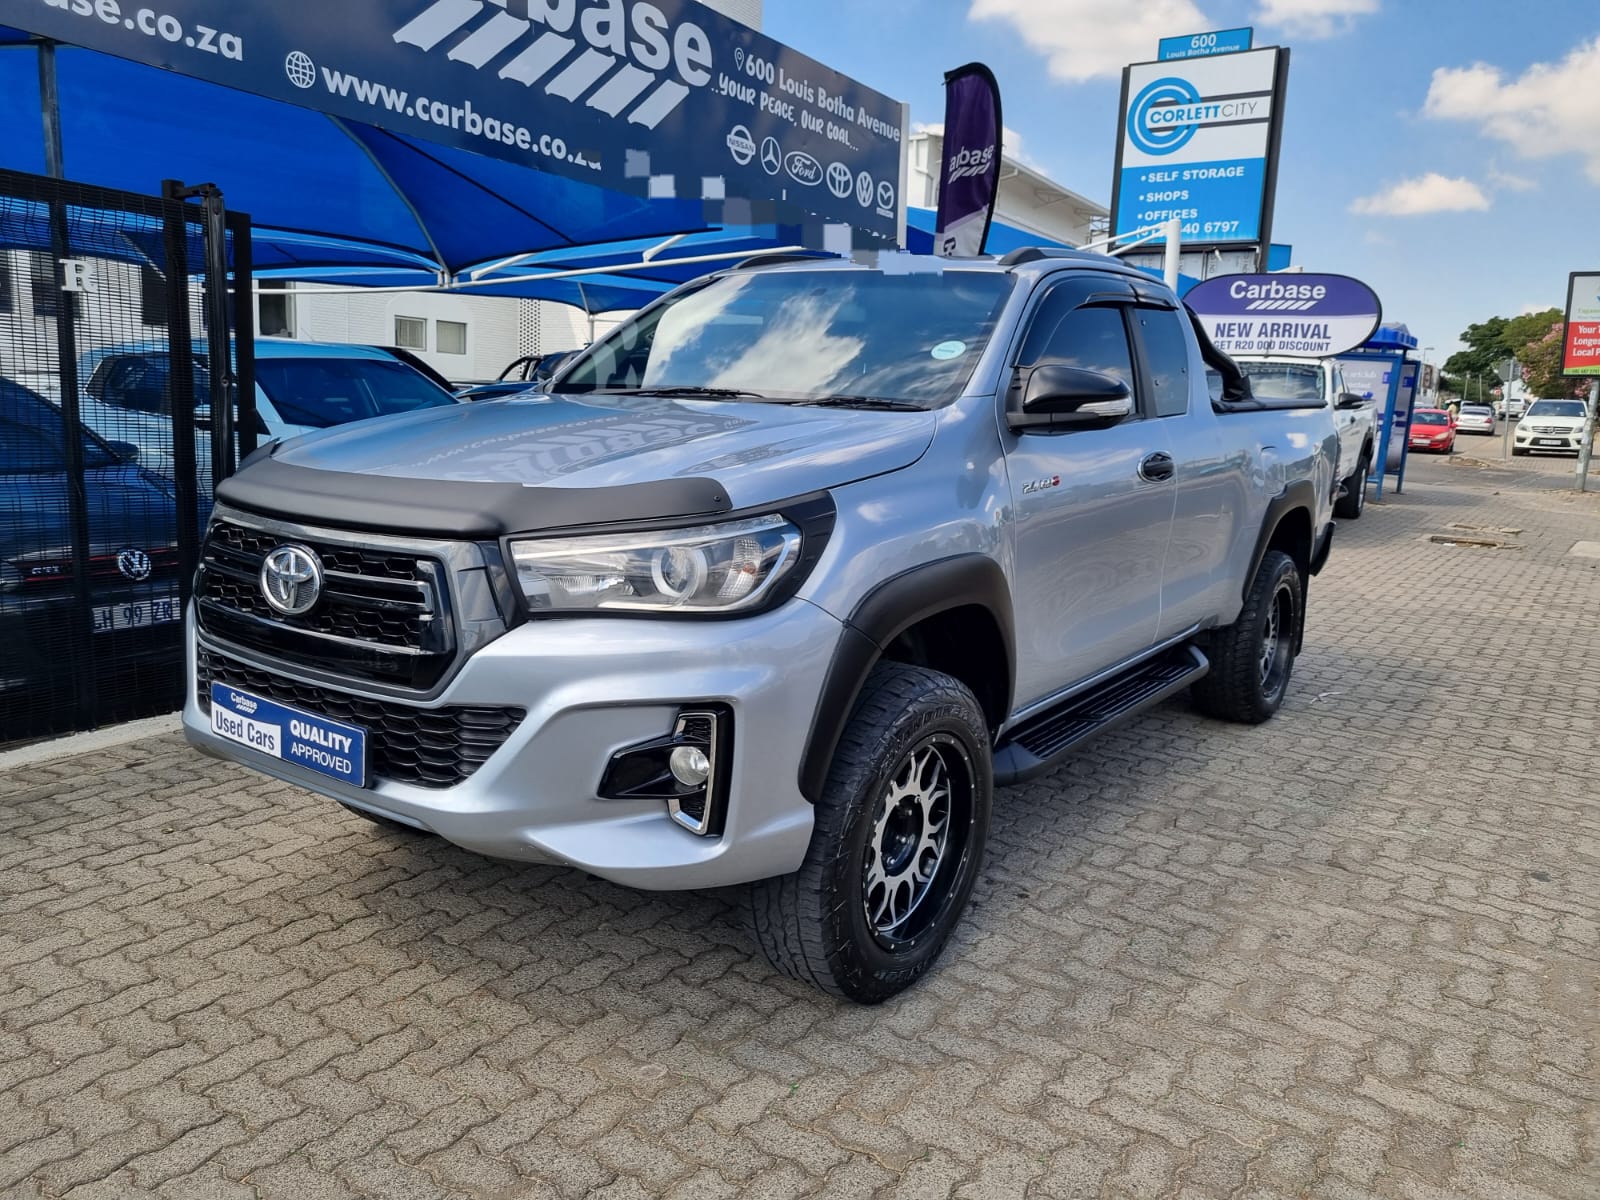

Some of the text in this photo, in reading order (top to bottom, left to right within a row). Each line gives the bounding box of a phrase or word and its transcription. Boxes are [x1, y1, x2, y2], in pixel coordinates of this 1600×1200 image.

[1191, 33, 1217, 49] 600
[1166, 45, 1240, 59] Louis Botha Avenue
[746, 54, 900, 142] 600 Louis Botha Avenue
[801, 110, 825, 136] OUR
[791, 156, 816, 180] Ford
[1148, 166, 1245, 183] SELF STORAGE
[1146, 190, 1189, 202] SHOPS
[1144, 208, 1198, 221] OFFICES
[1204, 221, 1239, 233] 6797
[1230, 280, 1326, 299] Carbase
[1215, 322, 1331, 339] NEW ARRIVAL
[1214, 340, 1331, 351] GET R20 000 DISCOUNT
[230, 692, 258, 710] Carbase
[215, 710, 275, 750] Used Cars
[290, 720, 352, 753] QUALITY
[291, 742, 352, 774] APPROVED
